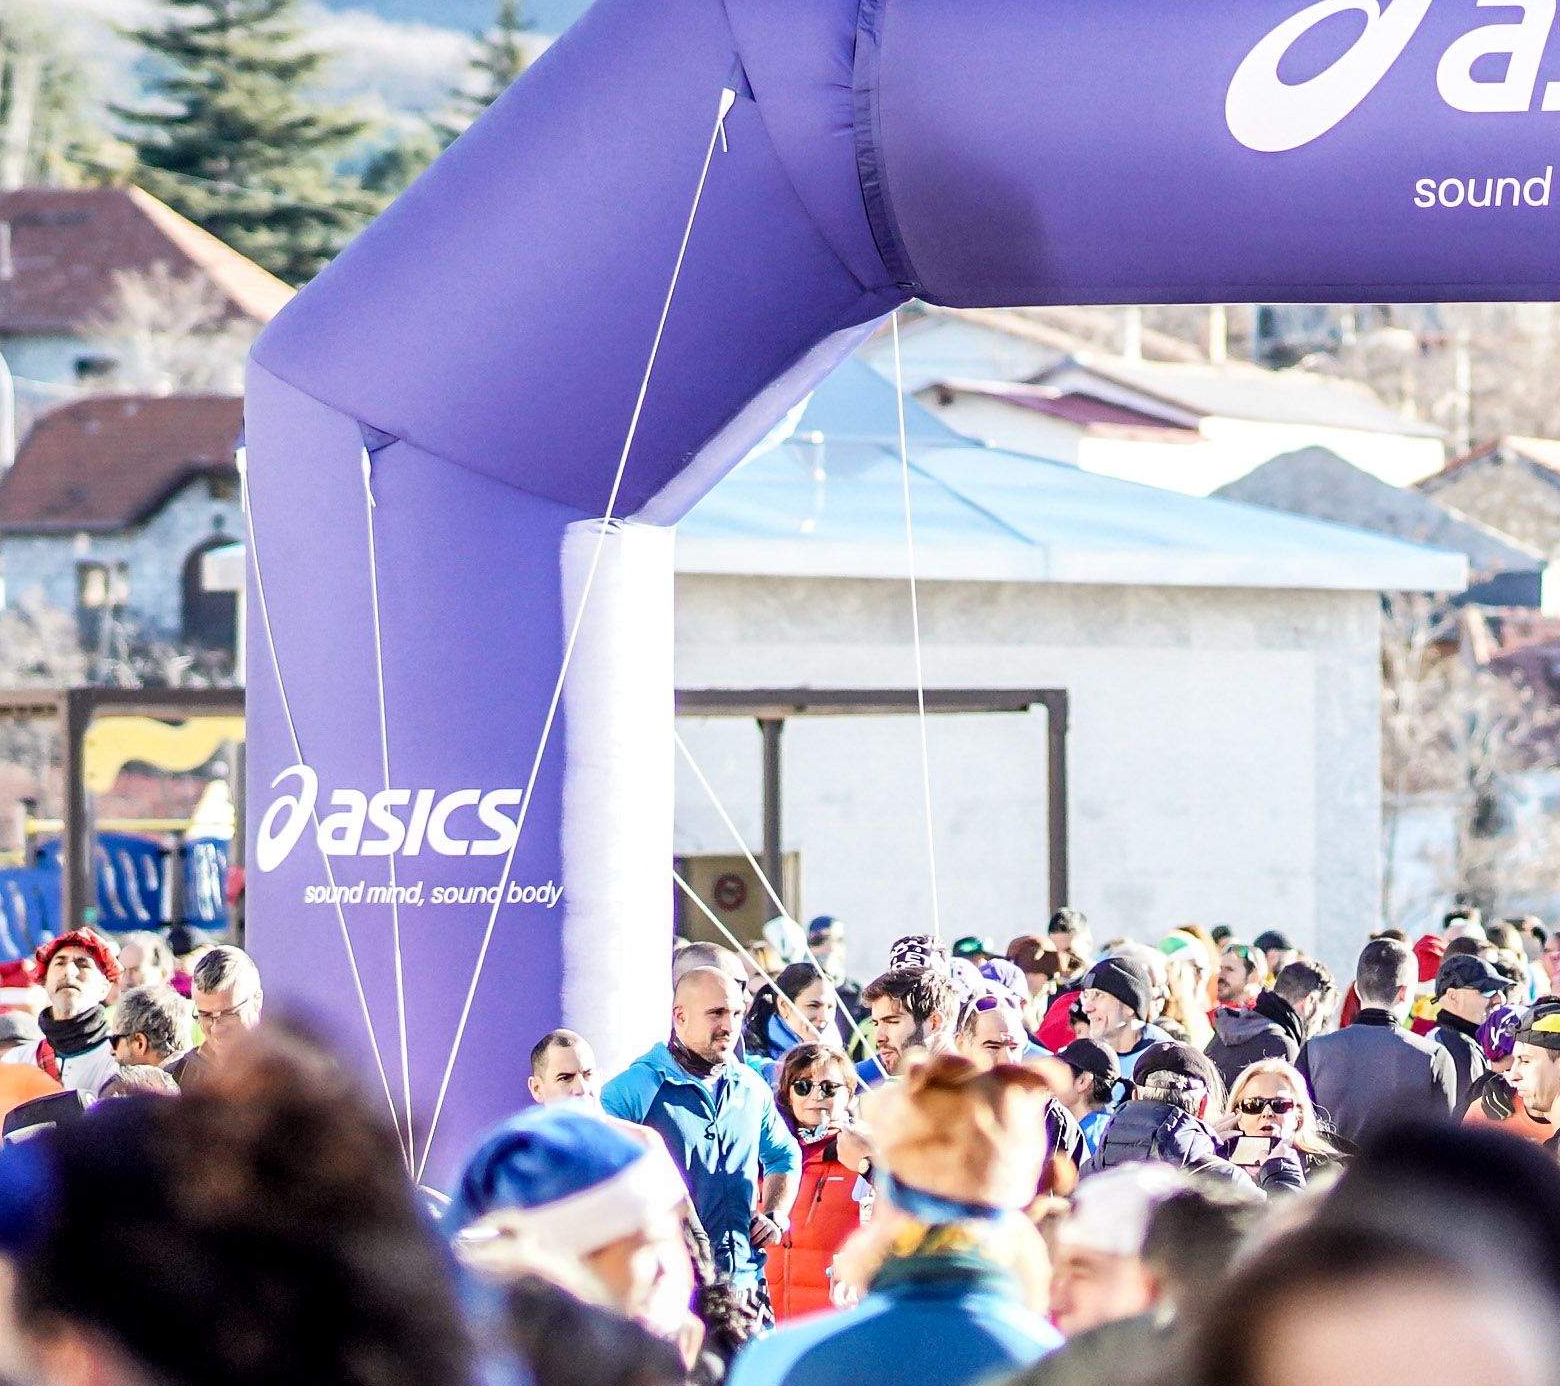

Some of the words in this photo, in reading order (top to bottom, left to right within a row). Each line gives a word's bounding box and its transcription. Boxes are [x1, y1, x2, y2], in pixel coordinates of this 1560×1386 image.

[1413, 165, 1553, 210] sound
[304, 880, 364, 905] sound
[366, 880, 426, 908] mind,
[430, 880, 500, 905] sound
[507, 880, 565, 909] body
